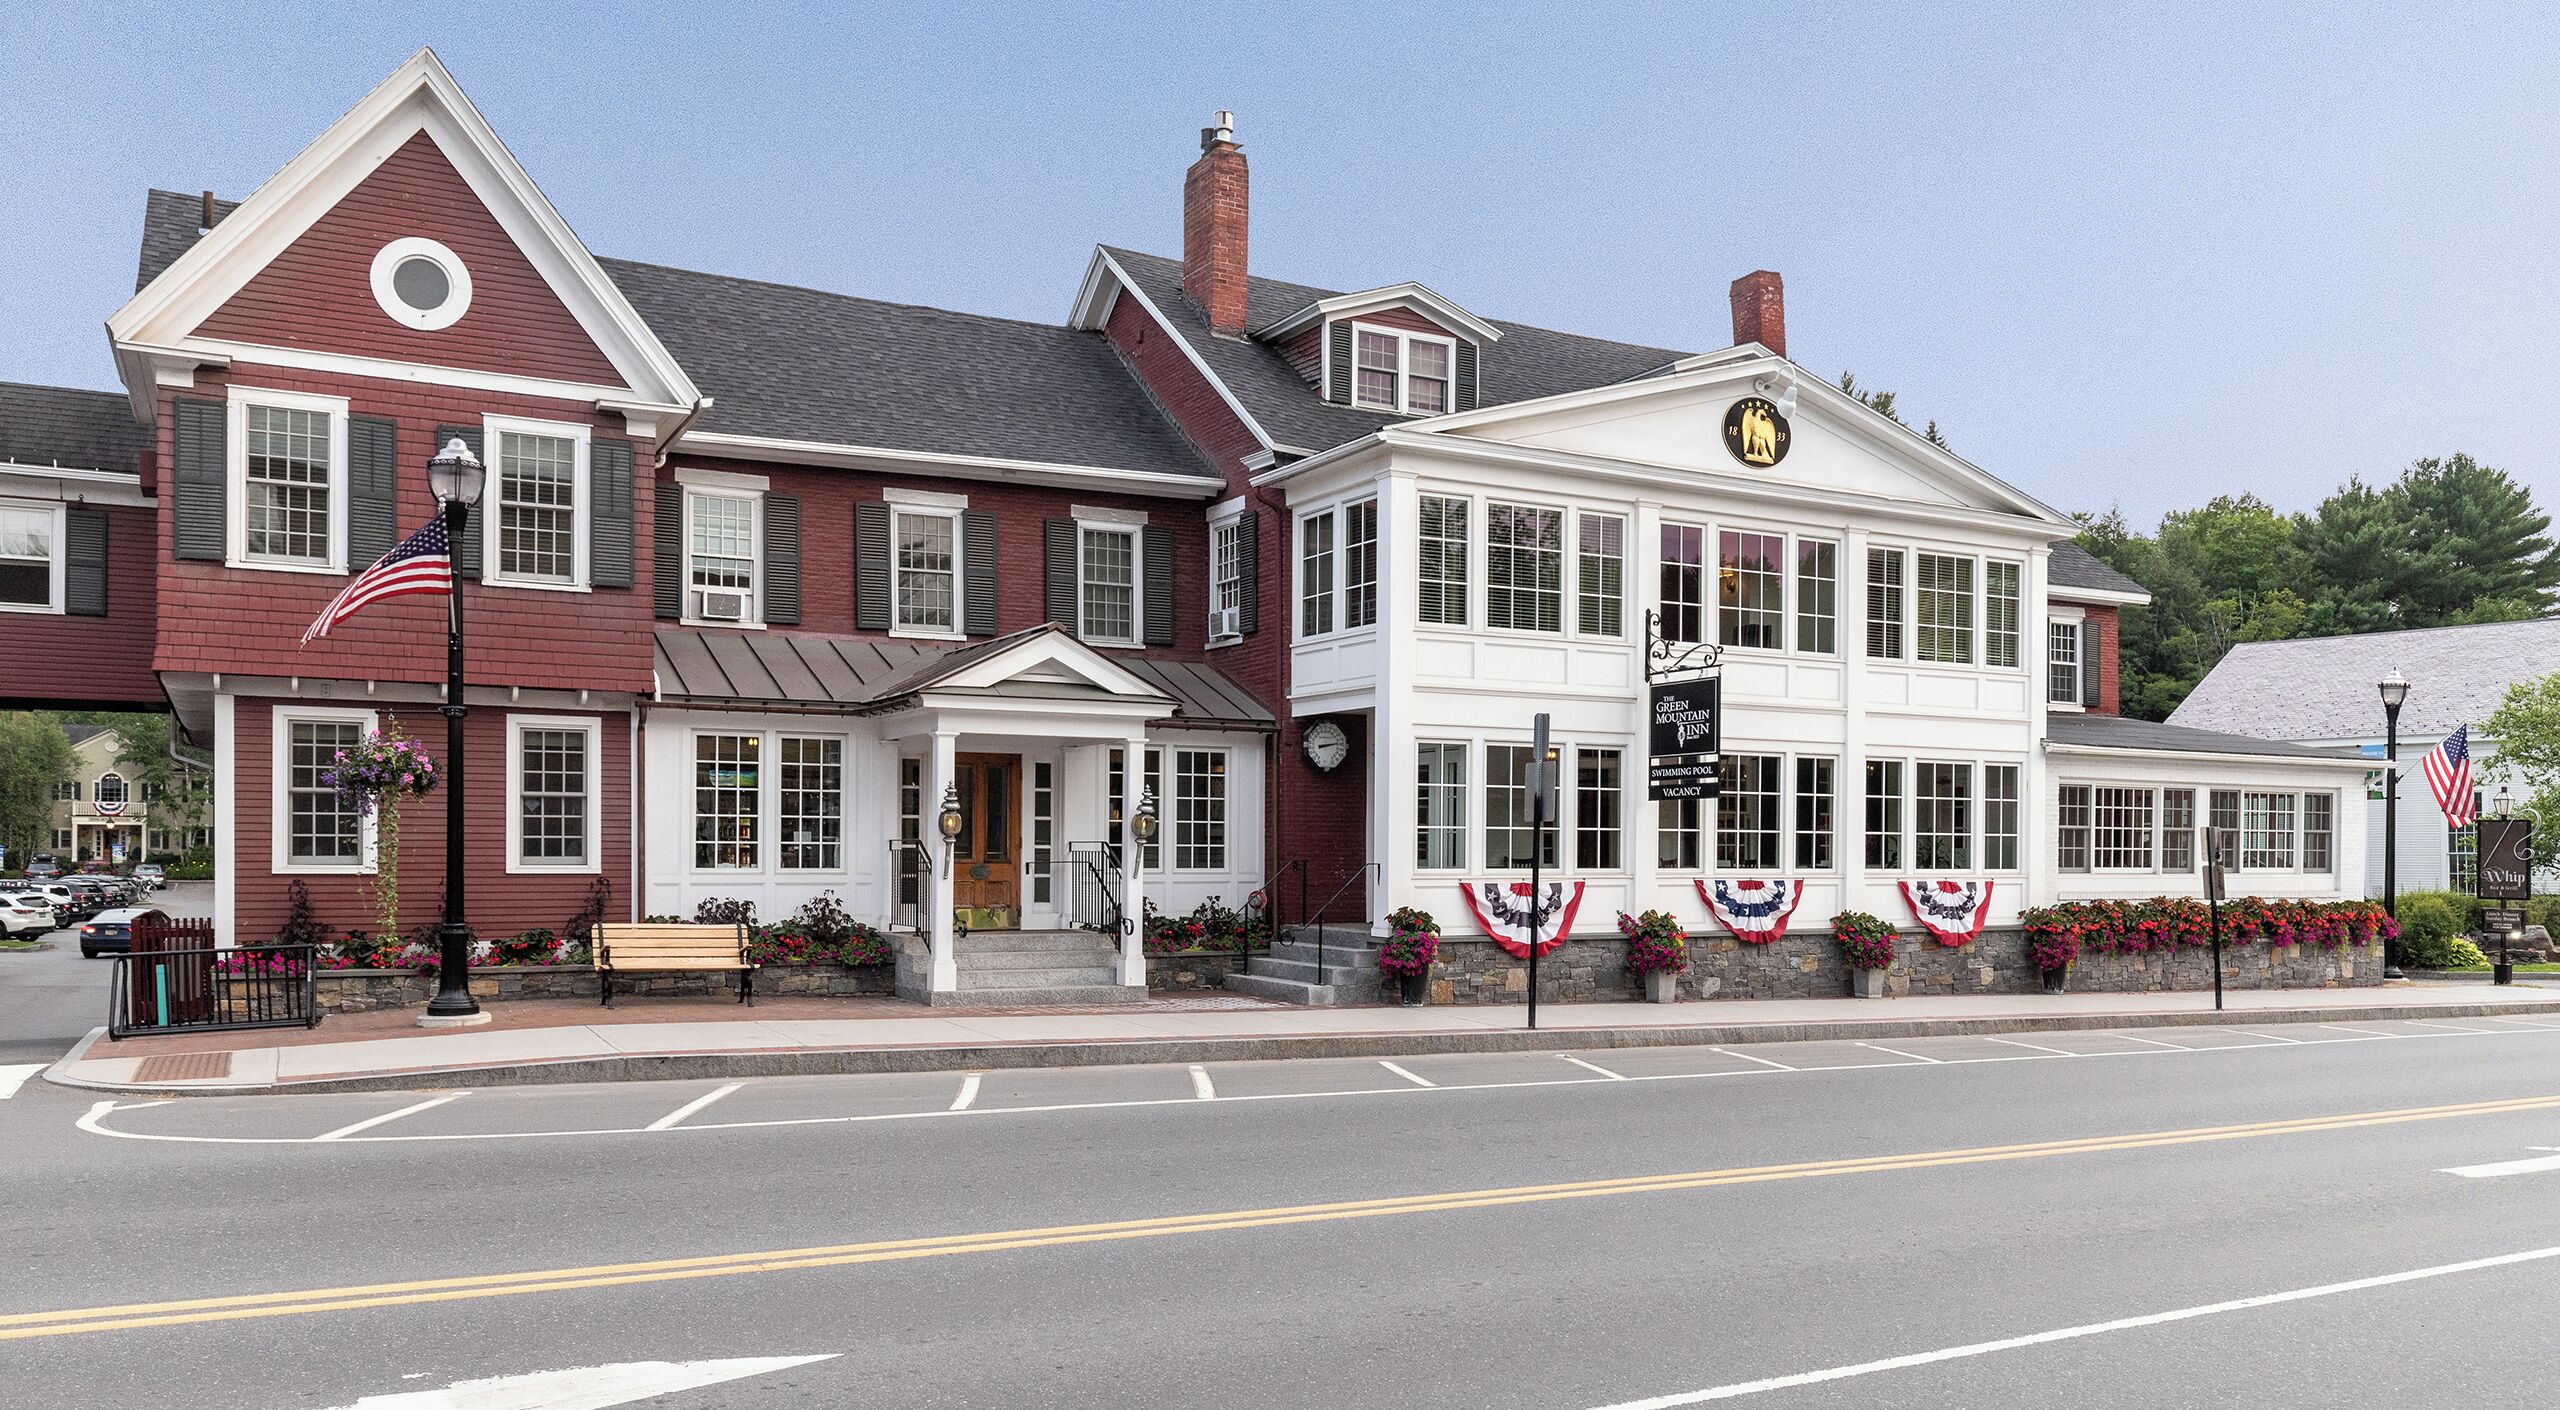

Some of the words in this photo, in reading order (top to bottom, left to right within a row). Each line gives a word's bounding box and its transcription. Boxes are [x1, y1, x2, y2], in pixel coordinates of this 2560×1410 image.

[1728, 426, 1739, 436] 18
[1776, 432, 1786, 442] 33
[1656, 700, 1689, 713] GREEN
[1656, 709, 1710, 724] MOUNTAIN
[1686, 723, 1710, 735] INN
[1651, 767, 1692, 777] SWIMMING
[1692, 766, 1714, 775] POOL
[1662, 786, 1702, 797] VACANCY
[2481, 867, 2526, 887] Whip
